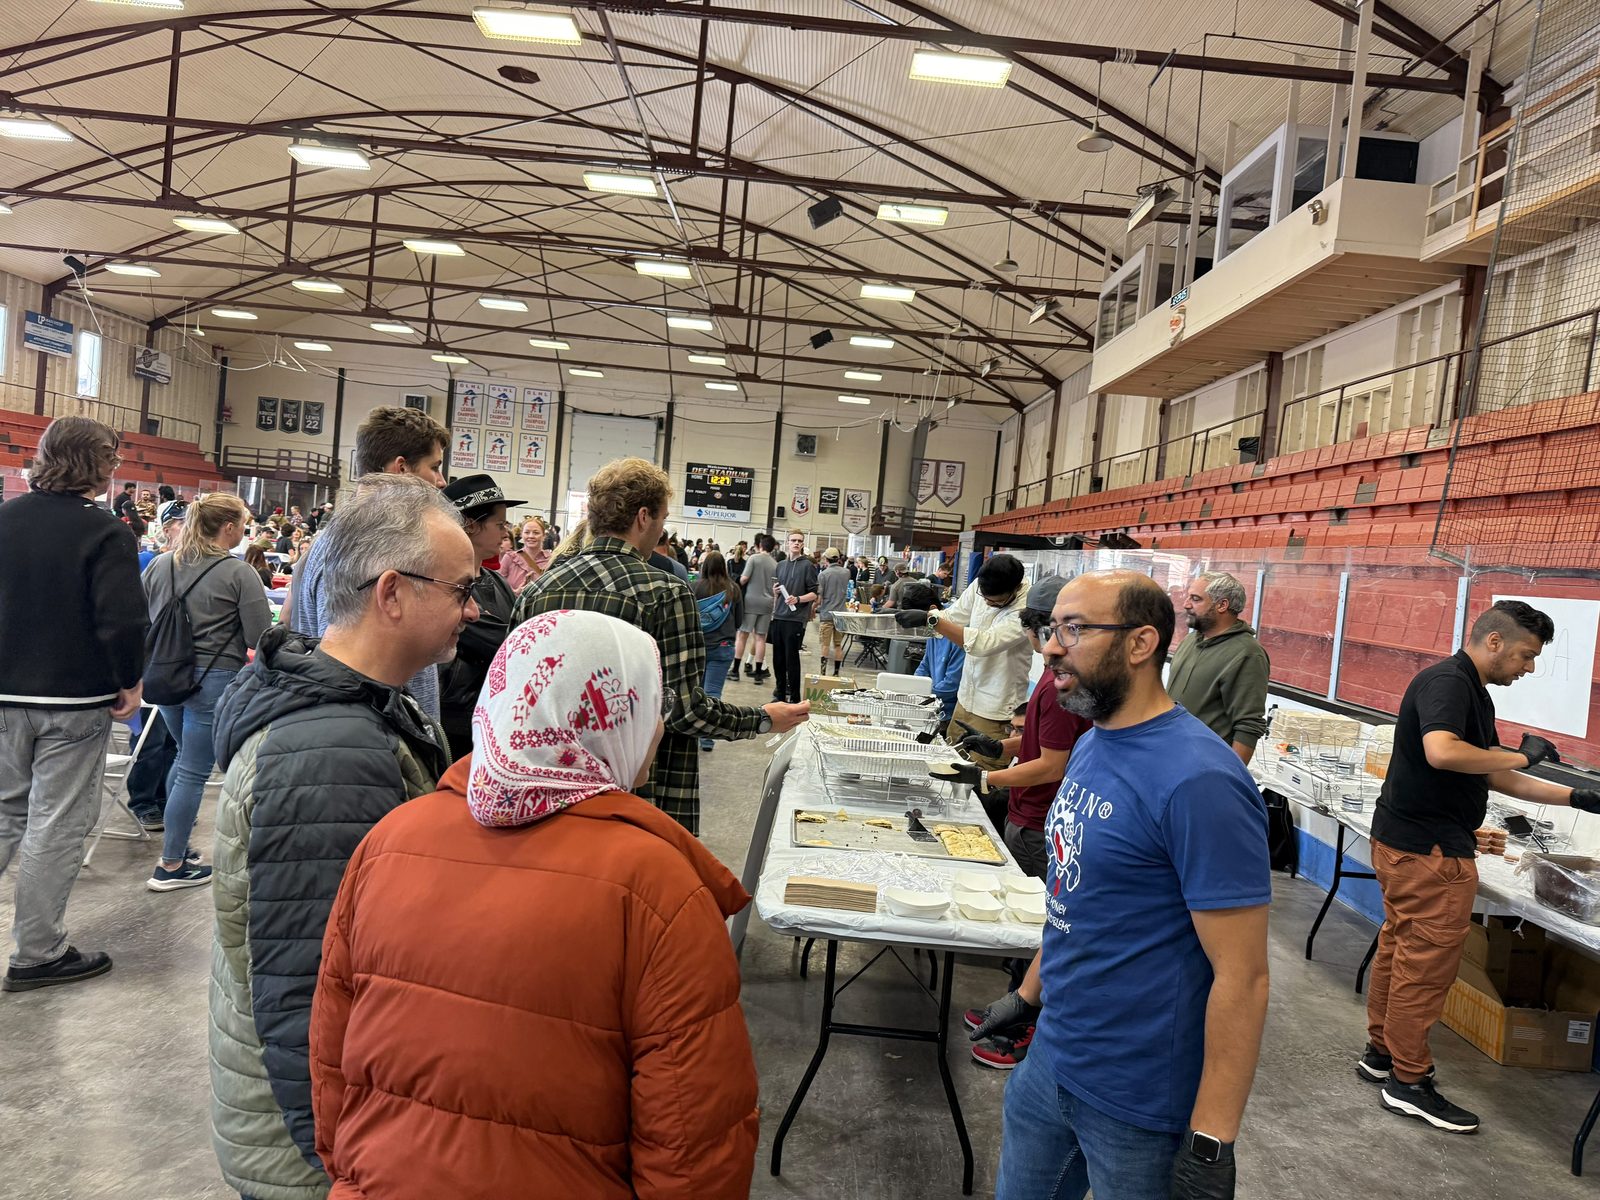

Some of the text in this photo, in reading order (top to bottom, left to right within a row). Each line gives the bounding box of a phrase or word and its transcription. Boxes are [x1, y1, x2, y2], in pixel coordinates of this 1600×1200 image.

[261, 415, 273, 425] 15
[285, 418, 293, 428] 4
[305, 420, 319, 429] 22
[709, 469, 749, 478] STADIUM
[711, 475, 730, 485] 12:27
[704, 510, 736, 518] SUPERIOR
